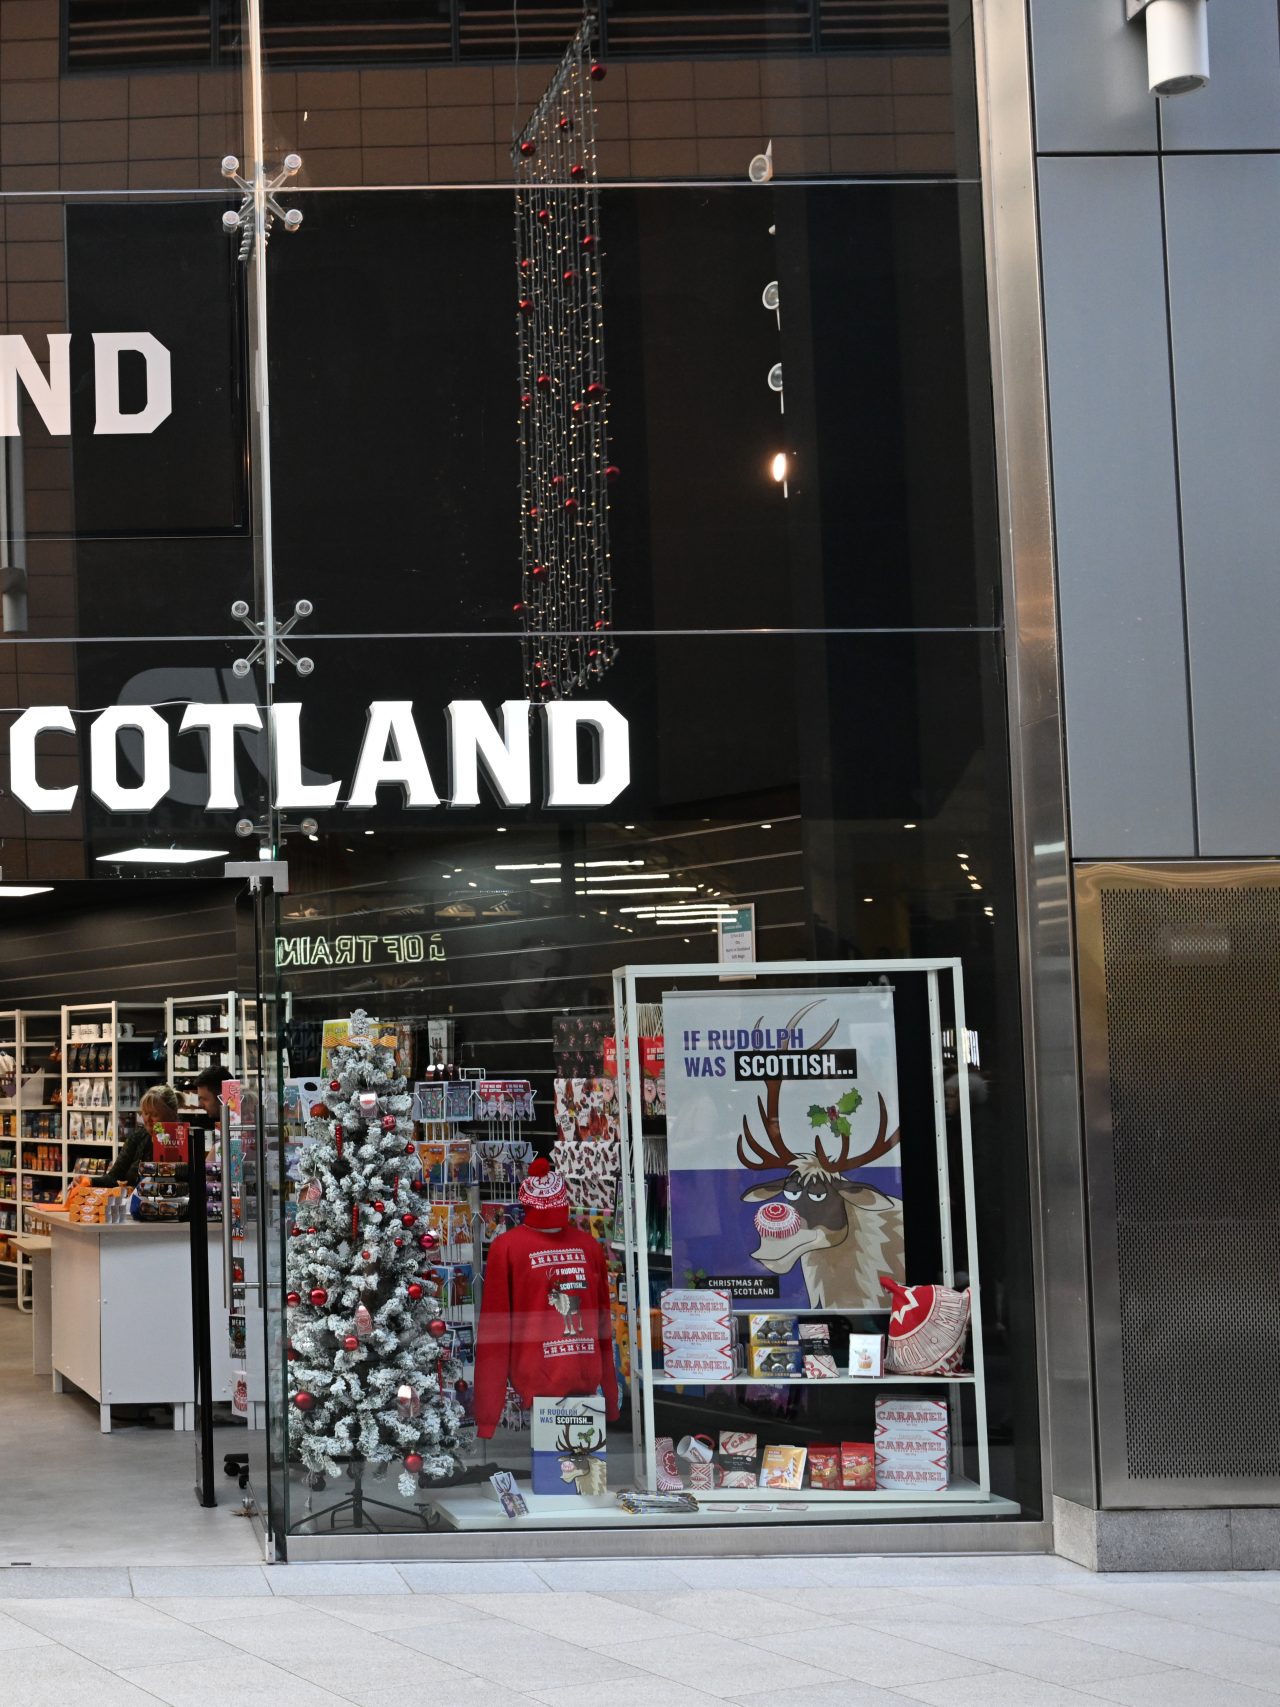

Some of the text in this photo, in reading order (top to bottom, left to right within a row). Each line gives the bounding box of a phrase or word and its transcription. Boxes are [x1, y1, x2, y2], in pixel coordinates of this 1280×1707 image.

[683, 1028, 804, 1051] IF RUDOLPH
[684, 1056, 727, 1078] WAS
[708, 1279, 763, 1287] CHRISTMAS AT
[733, 1288, 774, 1296] SCOTLAND
[662, 1301, 727, 1311] CARAMEL
[664, 1330, 728, 1340] CARAMEL
[665, 1360, 730, 1370] CARAMEL
[877, 1411, 945, 1421] CARAMEL
[876, 1441, 945, 1451] CARAMEL
[876, 1470, 945, 1481] CARAMEL
